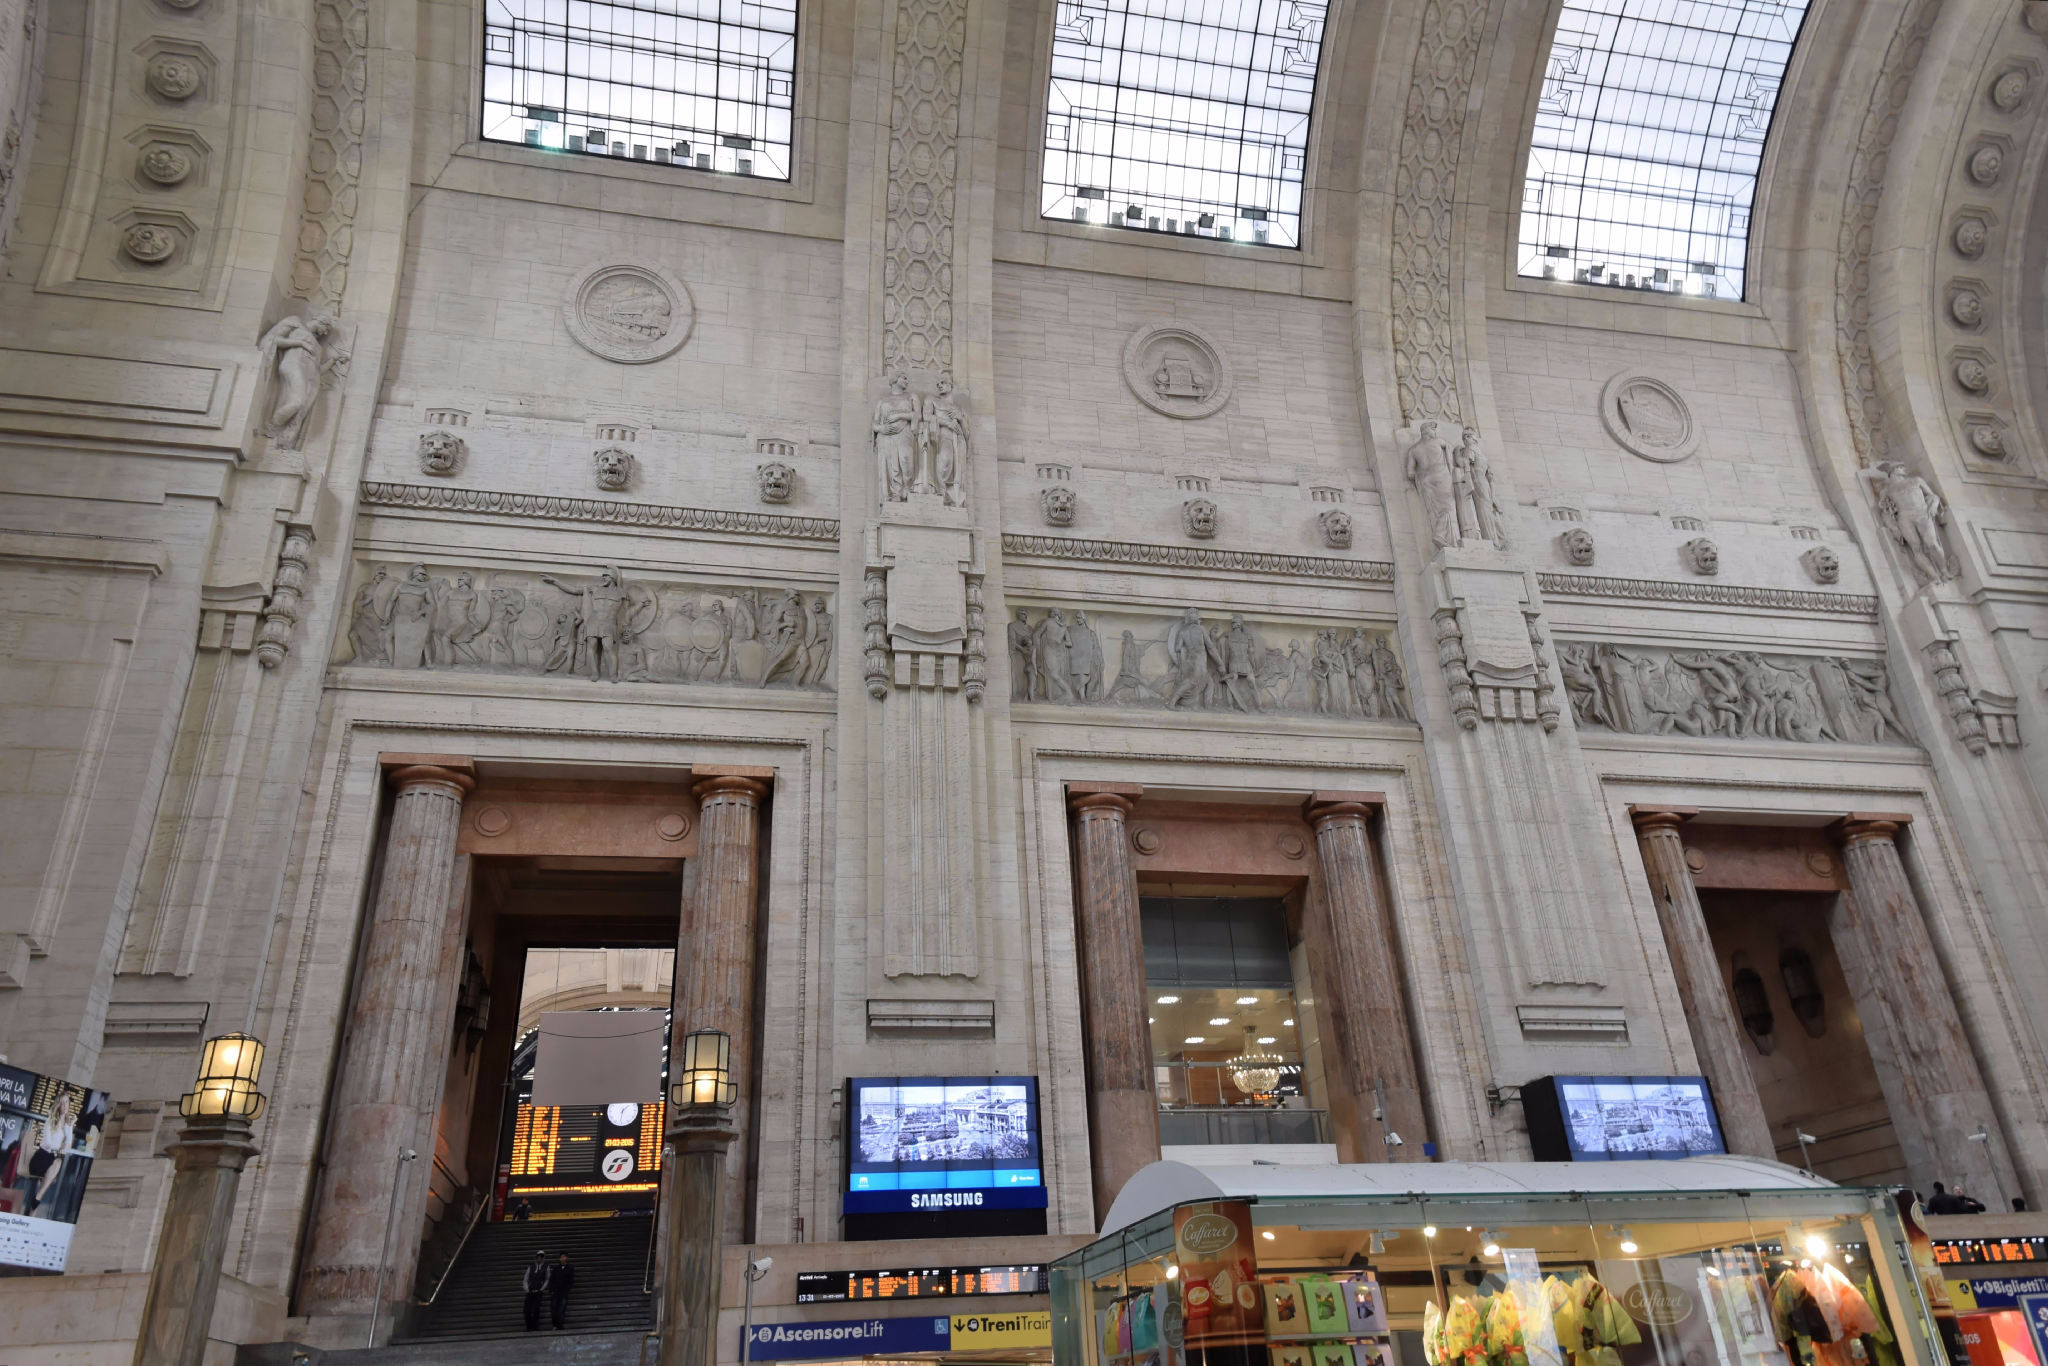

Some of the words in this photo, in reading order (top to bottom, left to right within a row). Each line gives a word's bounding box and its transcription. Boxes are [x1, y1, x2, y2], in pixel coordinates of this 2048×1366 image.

[0, 1077, 13, 1090] PRI
[14, 1081, 25, 1094] LA
[0, 1090, 10, 1103] VA
[13, 1094, 27, 1109] VIA
[911, 1192, 983, 1208] SAMSUNG
[1184, 1221, 1229, 1247] Caffarel
[1629, 1288, 1685, 1316] Caffarel
